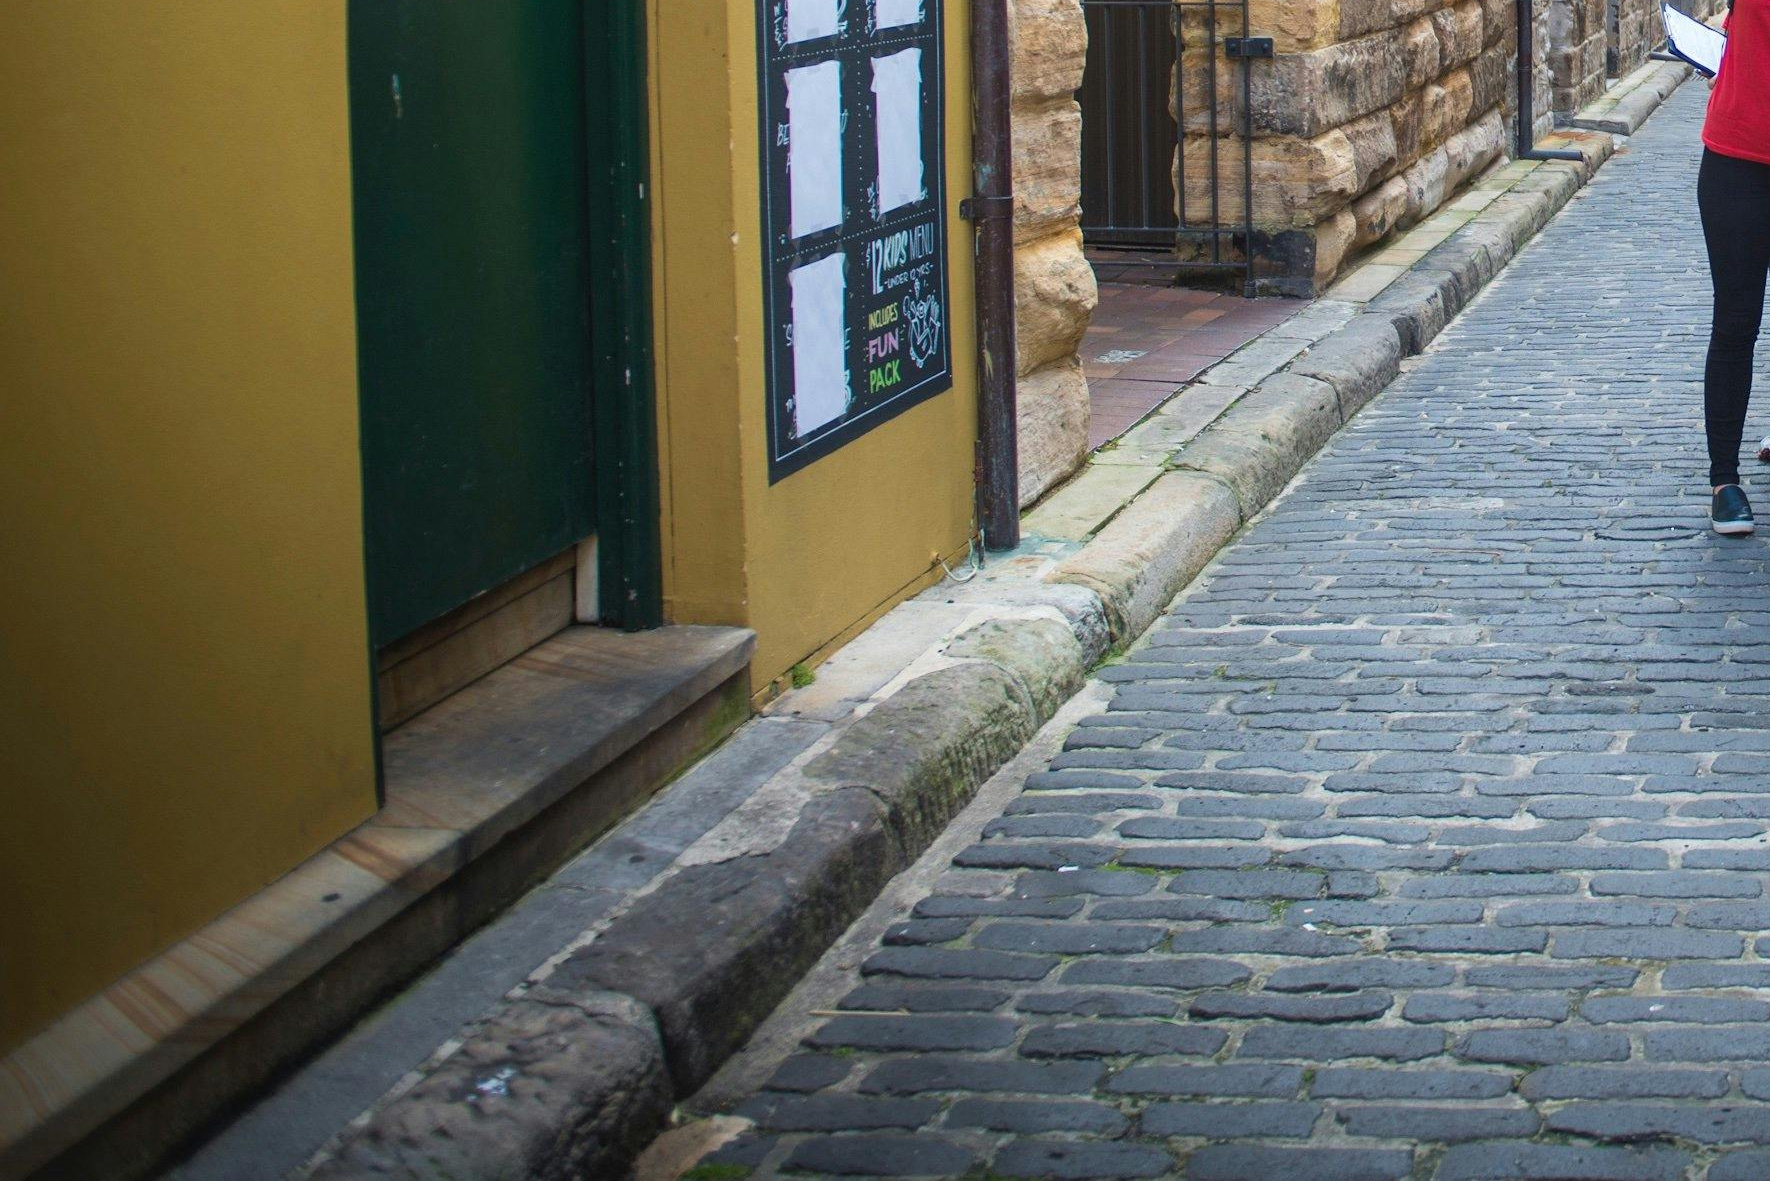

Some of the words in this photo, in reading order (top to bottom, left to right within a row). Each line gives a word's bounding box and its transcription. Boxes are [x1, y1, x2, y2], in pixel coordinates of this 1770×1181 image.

[883, 230, 908, 270] KIDS
[909, 222, 934, 261] MENU
[868, 302, 898, 331] INCLUDES
[868, 327, 899, 363] FUN
[870, 359, 901, 394] PACK
